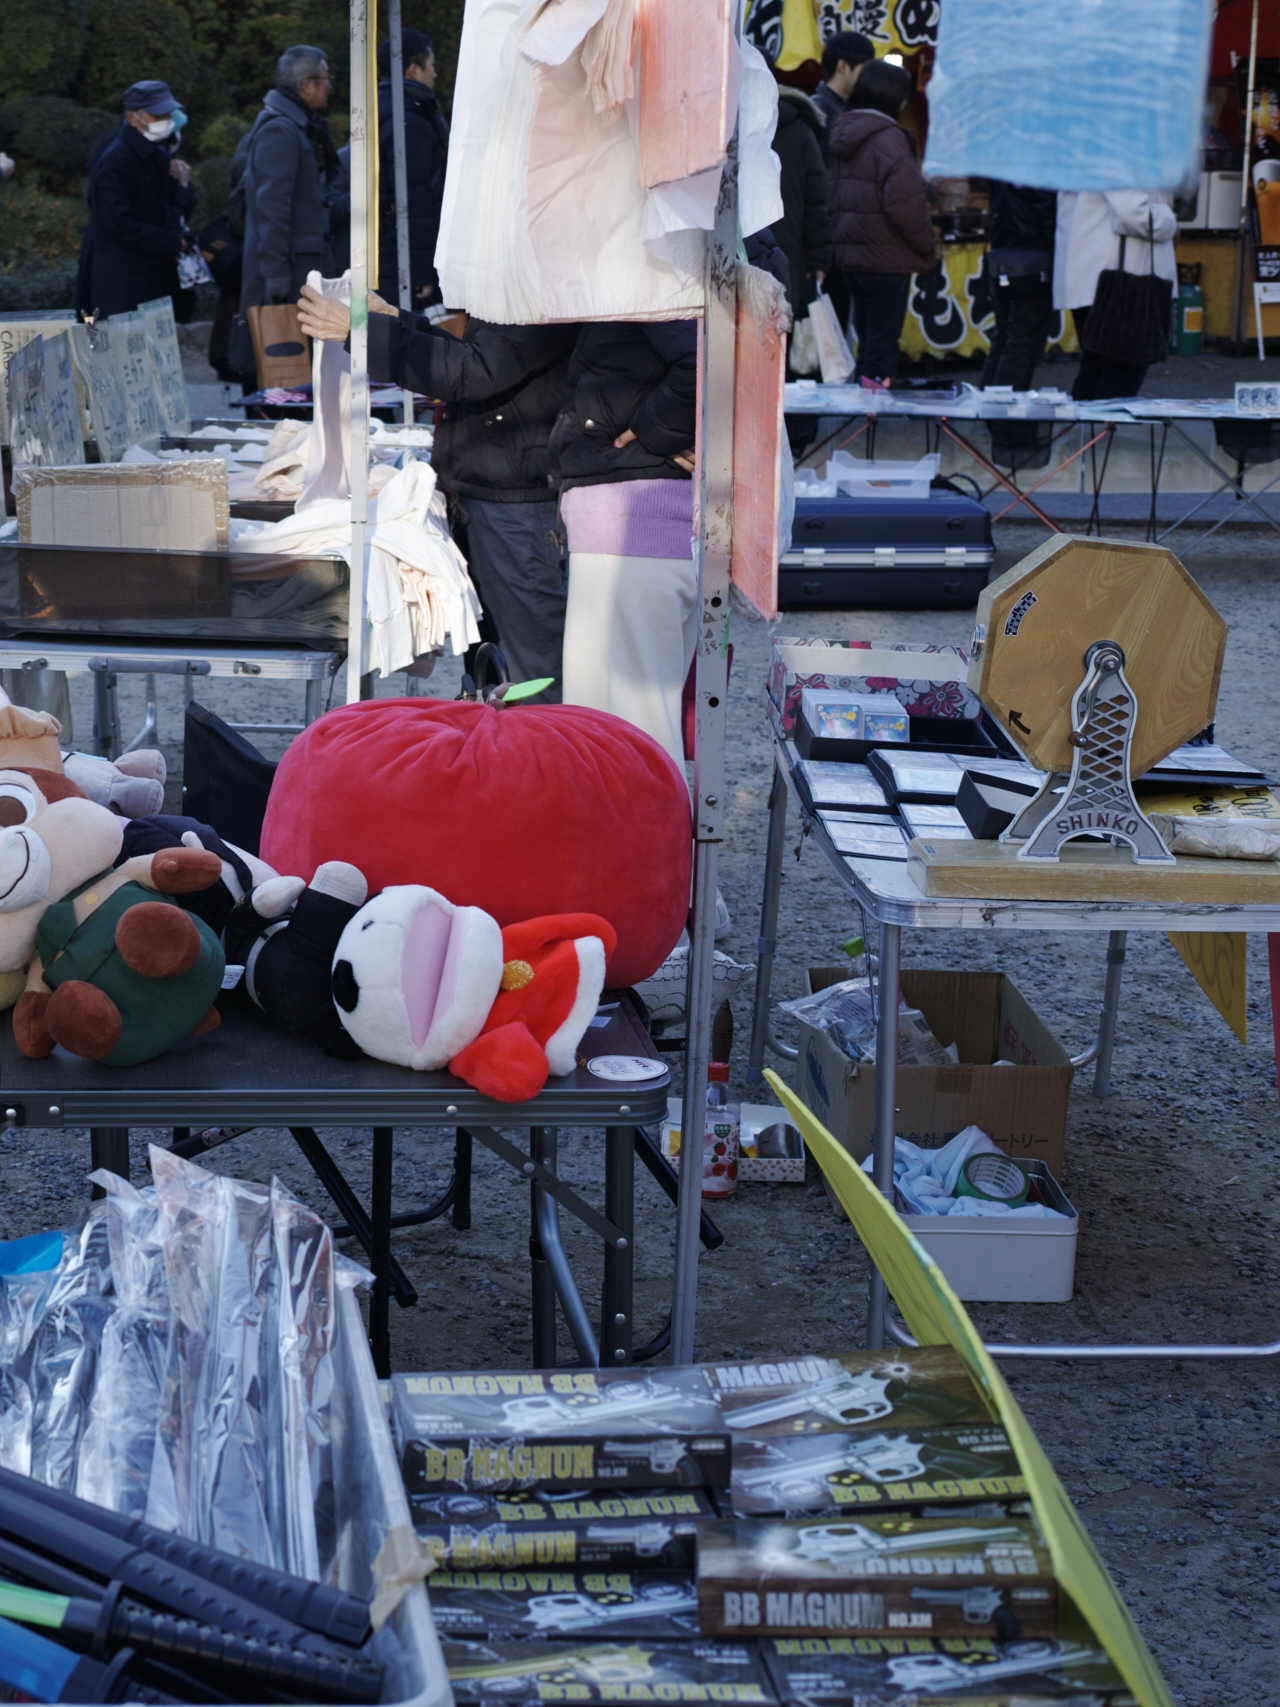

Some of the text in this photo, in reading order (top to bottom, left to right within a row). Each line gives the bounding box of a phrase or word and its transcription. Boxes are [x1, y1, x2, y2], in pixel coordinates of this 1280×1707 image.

[1056, 811, 1138, 835] SHINKO
[405, 1373, 597, 1395] BB MAGNUM
[715, 1358, 844, 1388] MAGNUM
[425, 1445, 594, 1481] BB MAGNUM
[829, 1475, 1029, 1503] BB MAGNUM
[497, 1494, 701, 1521] BB MAGNUM
[452, 1531, 577, 1565] MAGNUM
[991, 1558, 1040, 1576] BB
[429, 1571, 632, 1592] BB MAGNUM
[724, 1592, 885, 1628] BB MAGNUM
[773, 1638, 935, 1656] MAGNUM
[537, 1683, 766, 1701] BB MAGNUM
